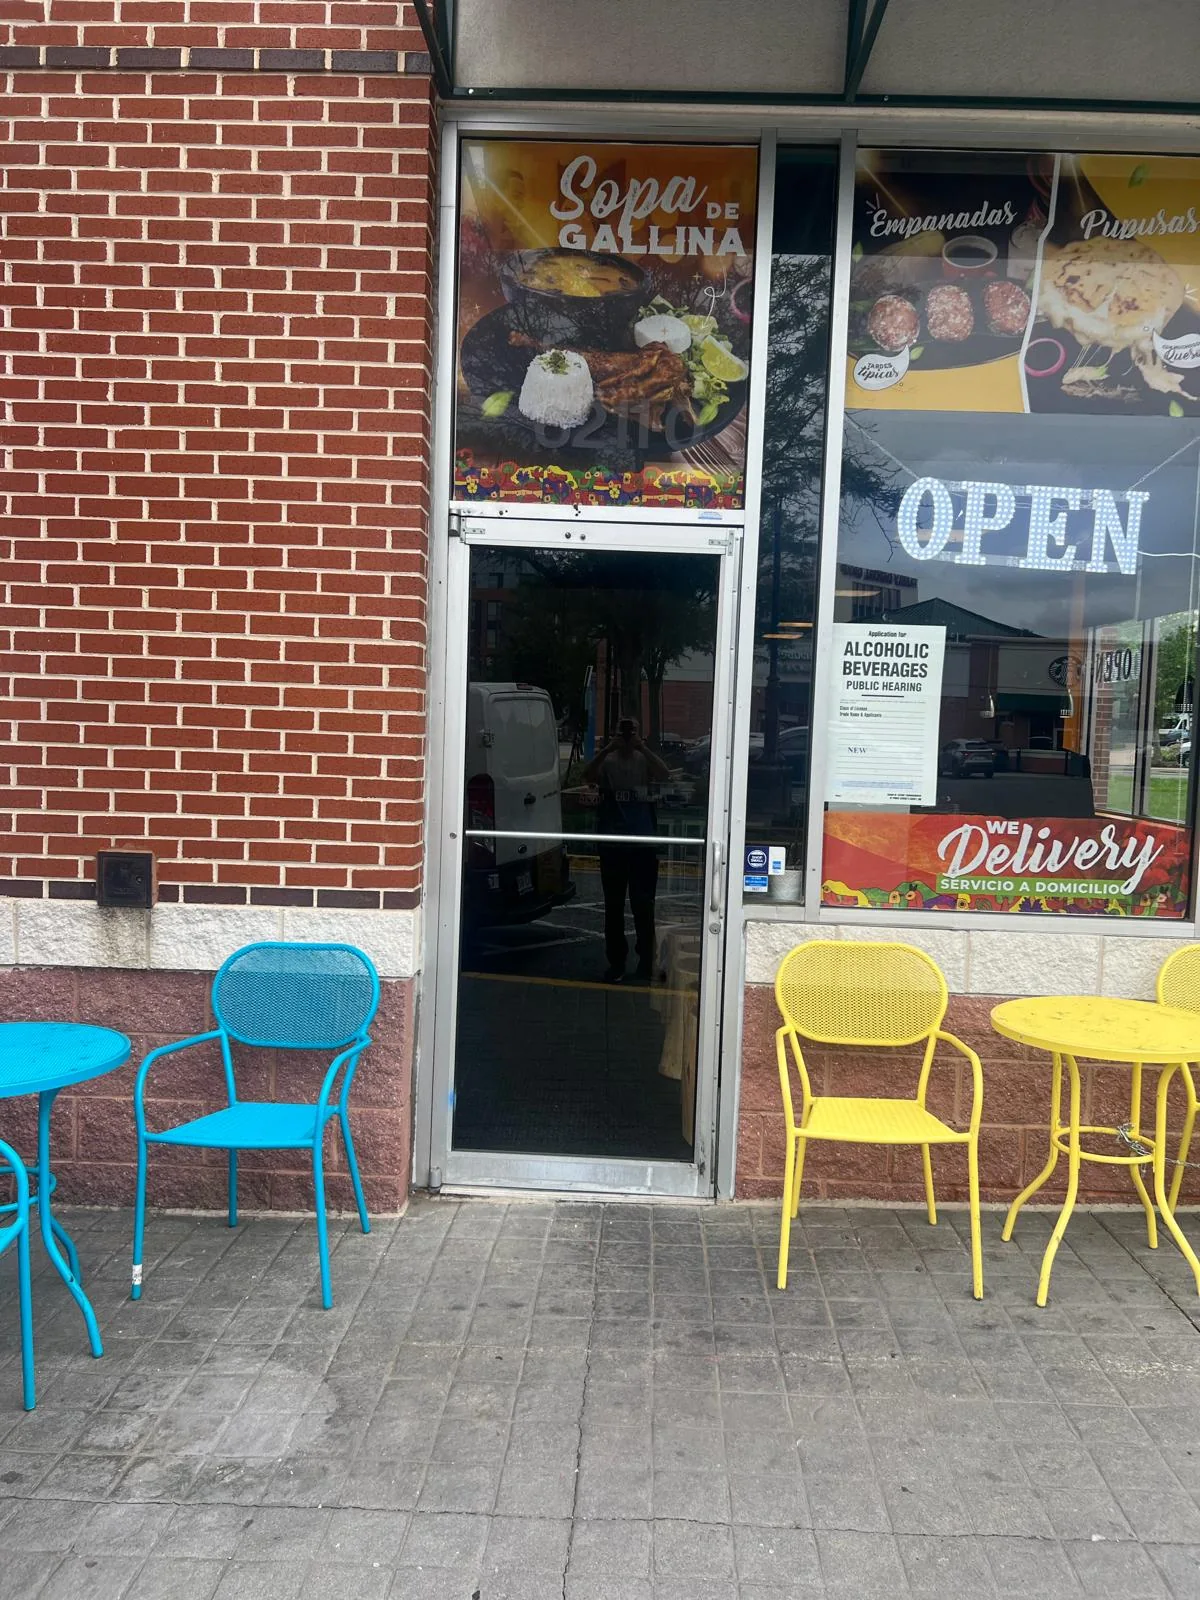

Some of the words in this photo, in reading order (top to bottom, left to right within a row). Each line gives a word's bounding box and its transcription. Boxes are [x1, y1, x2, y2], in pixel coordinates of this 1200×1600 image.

[550, 155, 708, 242] Sopa
[706, 202, 740, 220] DE
[869, 200, 1018, 239] Empanadas
[1080, 207, 1200, 241] Pupusas
[558, 224, 747, 257] GALLINA
[898, 476, 1150, 575] OPEN
[868, 630, 897, 638] Application
[844, 641, 929, 658] ALCOHOLIC
[842, 660, 928, 678] BEVERAGES
[846, 680, 880, 690] PUBLIC
[882, 681, 922, 692] HEARING
[985, 820, 1020, 835] WE
[937, 823, 1164, 895] Delivery
[940, 878, 1014, 892] SERVICIO
[1019, 880, 1031, 893] A
[1036, 881, 1122, 895] DOMICILIO
